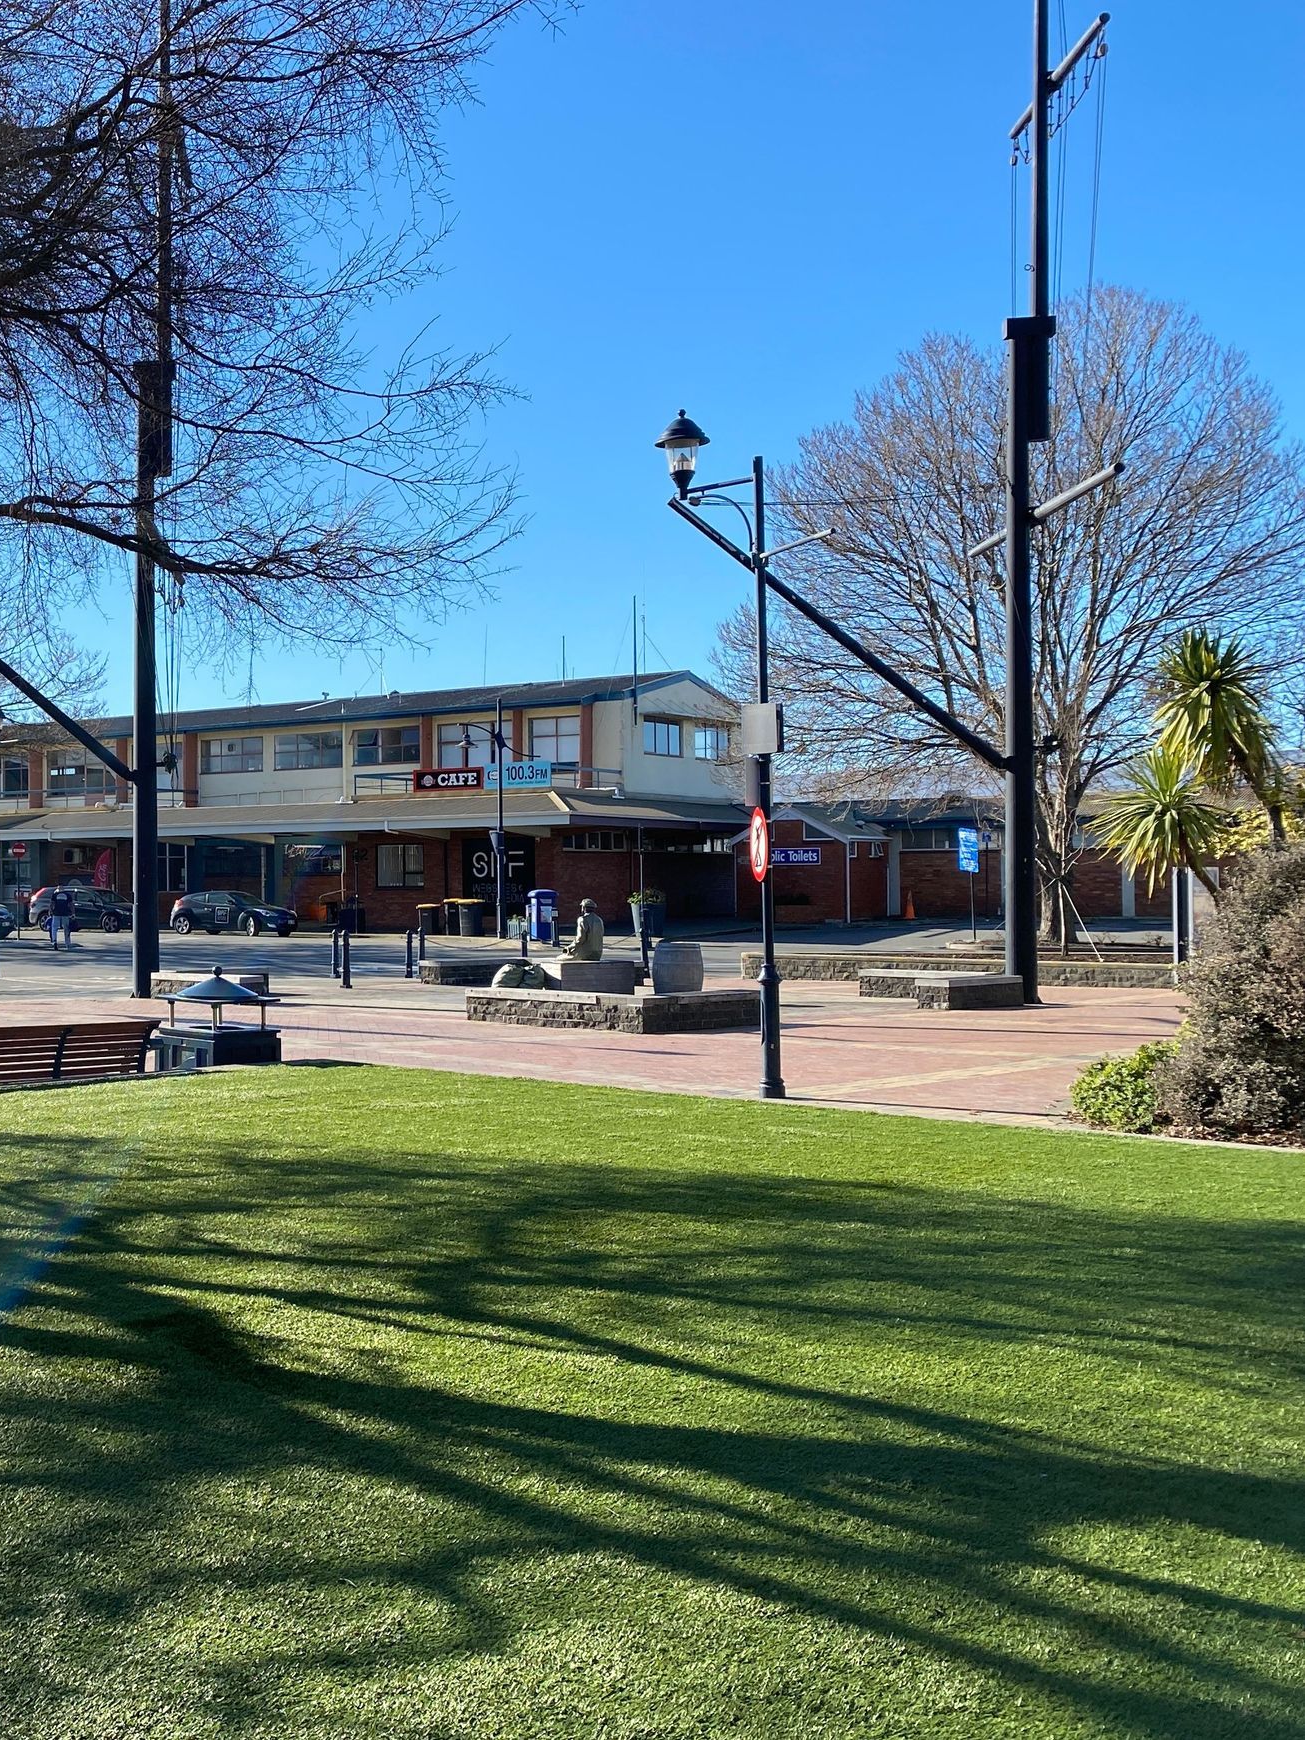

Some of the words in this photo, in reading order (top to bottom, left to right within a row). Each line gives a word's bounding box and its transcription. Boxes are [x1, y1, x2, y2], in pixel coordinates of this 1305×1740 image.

[438, 773, 477, 786] CAFE
[772, 850, 785, 862] lic
[787, 850, 818, 862] Toilets
